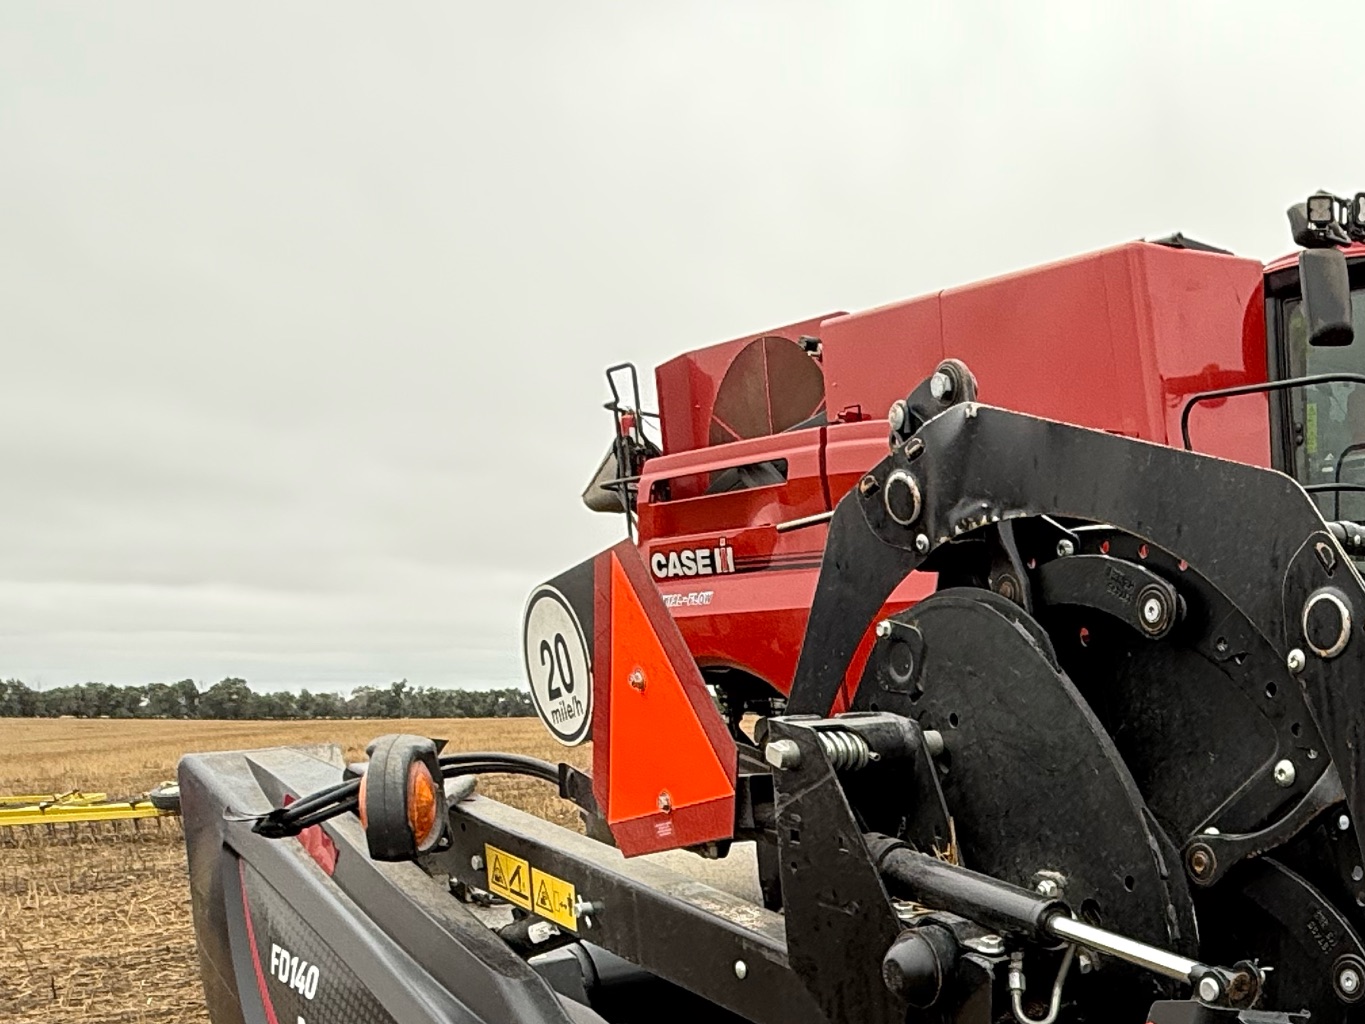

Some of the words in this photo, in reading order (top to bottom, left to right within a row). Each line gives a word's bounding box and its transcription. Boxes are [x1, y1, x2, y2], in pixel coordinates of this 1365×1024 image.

[651, 548, 713, 578] CASE
[539, 632, 575, 702] 20
[551, 695, 585, 725] mile/h
[270, 942, 320, 1000] FD140
